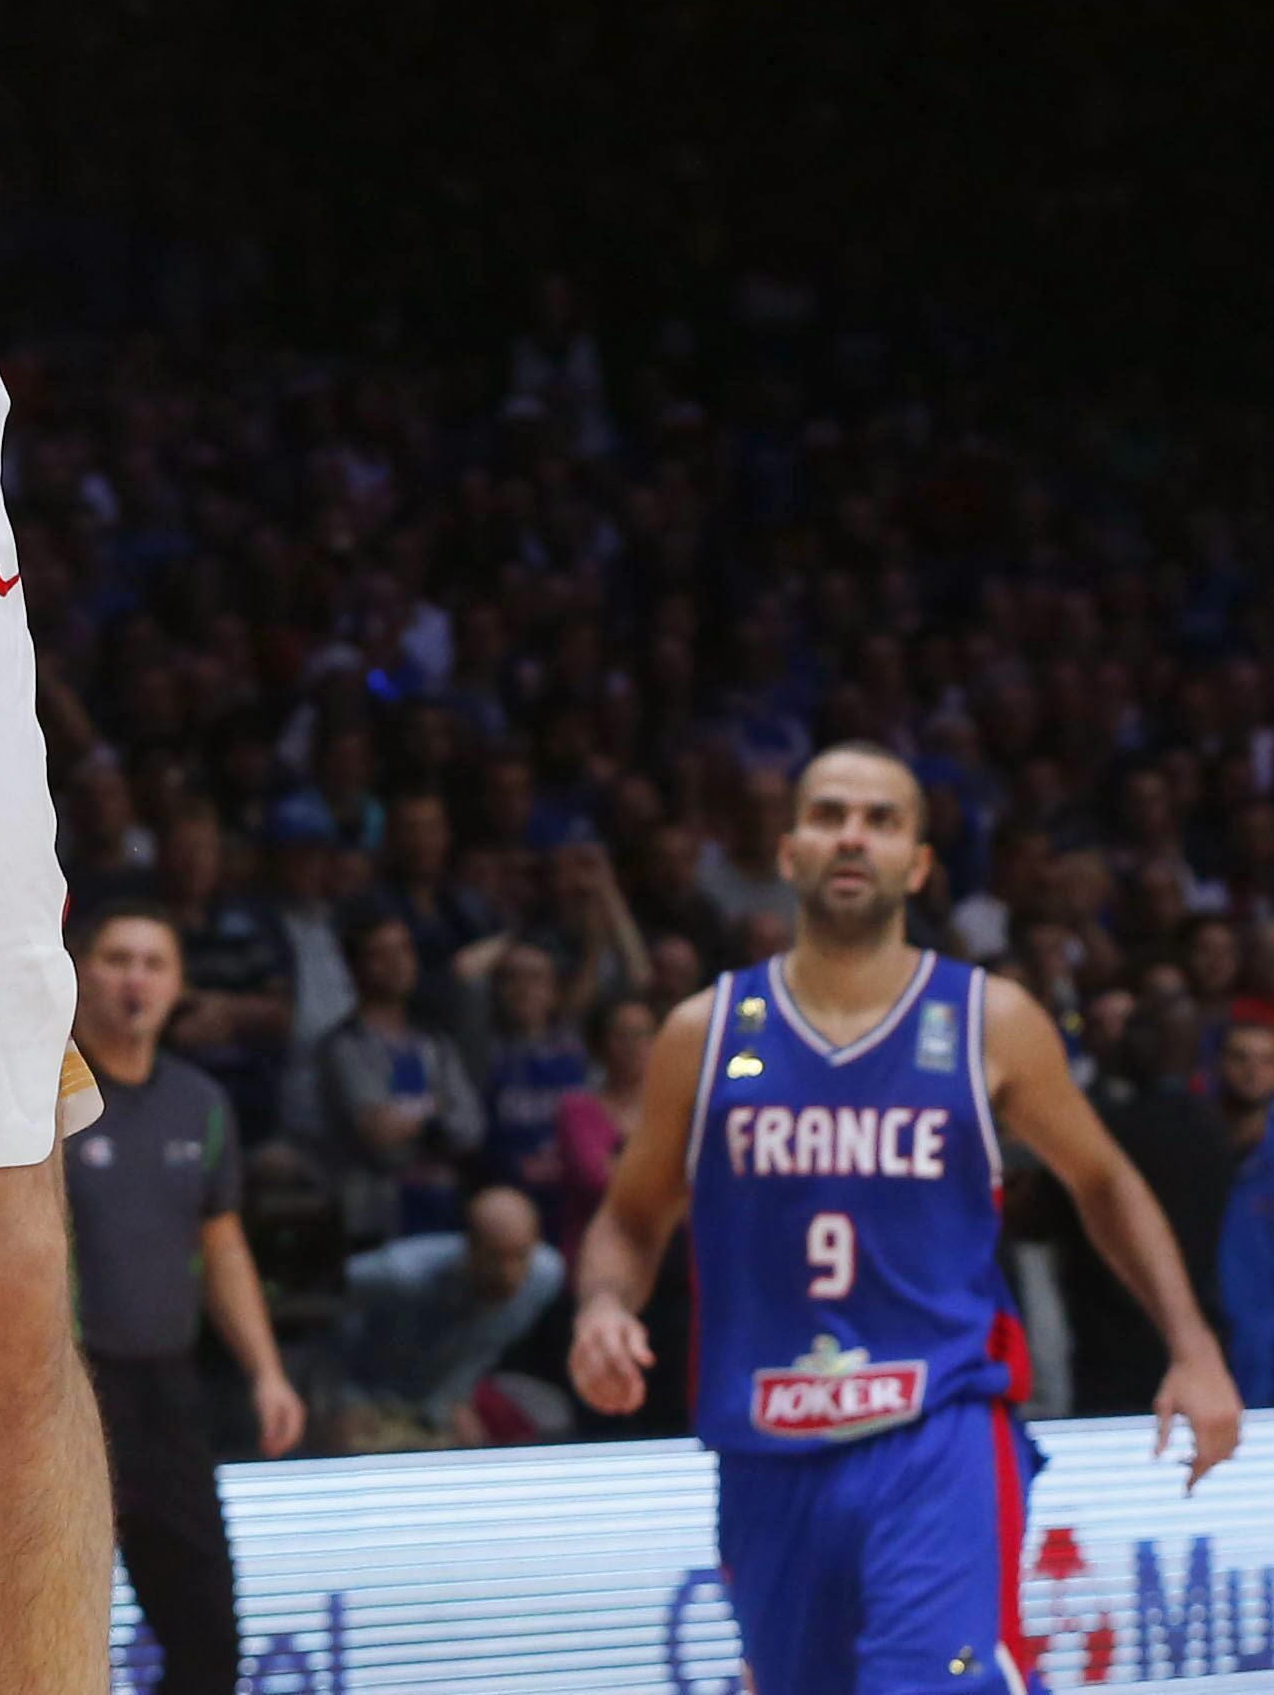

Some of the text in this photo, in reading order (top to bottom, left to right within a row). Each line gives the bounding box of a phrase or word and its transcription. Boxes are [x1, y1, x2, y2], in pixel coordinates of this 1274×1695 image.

[726, 1106, 948, 1179] FRANCE
[806, 1212, 856, 1299] 9
[764, 1375, 910, 1423] JOKER
